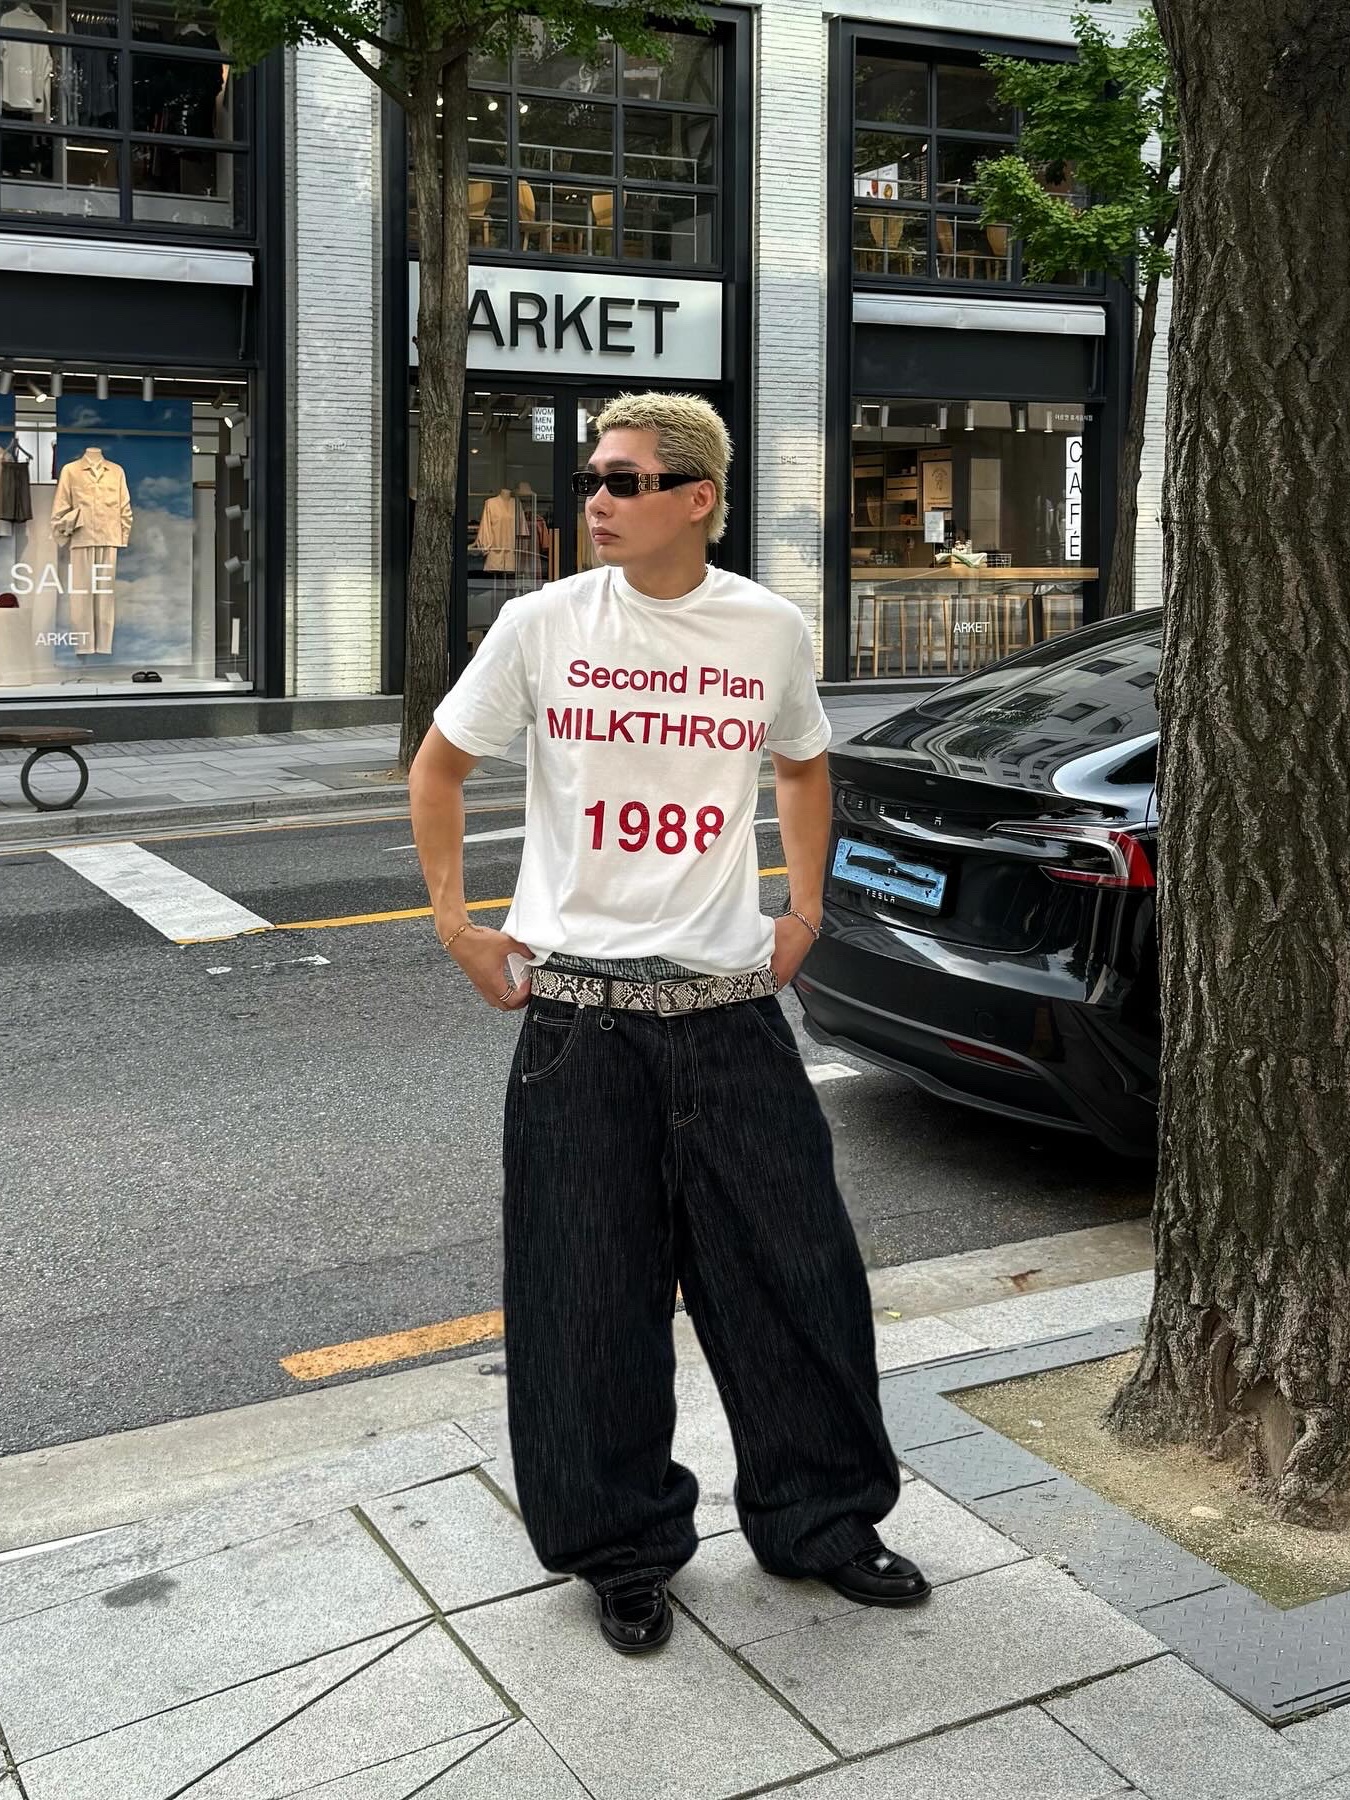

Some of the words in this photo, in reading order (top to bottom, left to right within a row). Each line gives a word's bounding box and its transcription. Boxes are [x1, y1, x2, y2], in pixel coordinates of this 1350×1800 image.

[468, 289, 680, 354] ARKET
[10, 563, 114, 595] SALE
[35, 632, 90, 646] ARKET
[953, 621, 990, 633] ARKET
[567, 660, 688, 694] Second
[699, 667, 764, 701] Plan
[584, 800, 725, 855] 1988
[866, 888, 896, 903] TESLA
